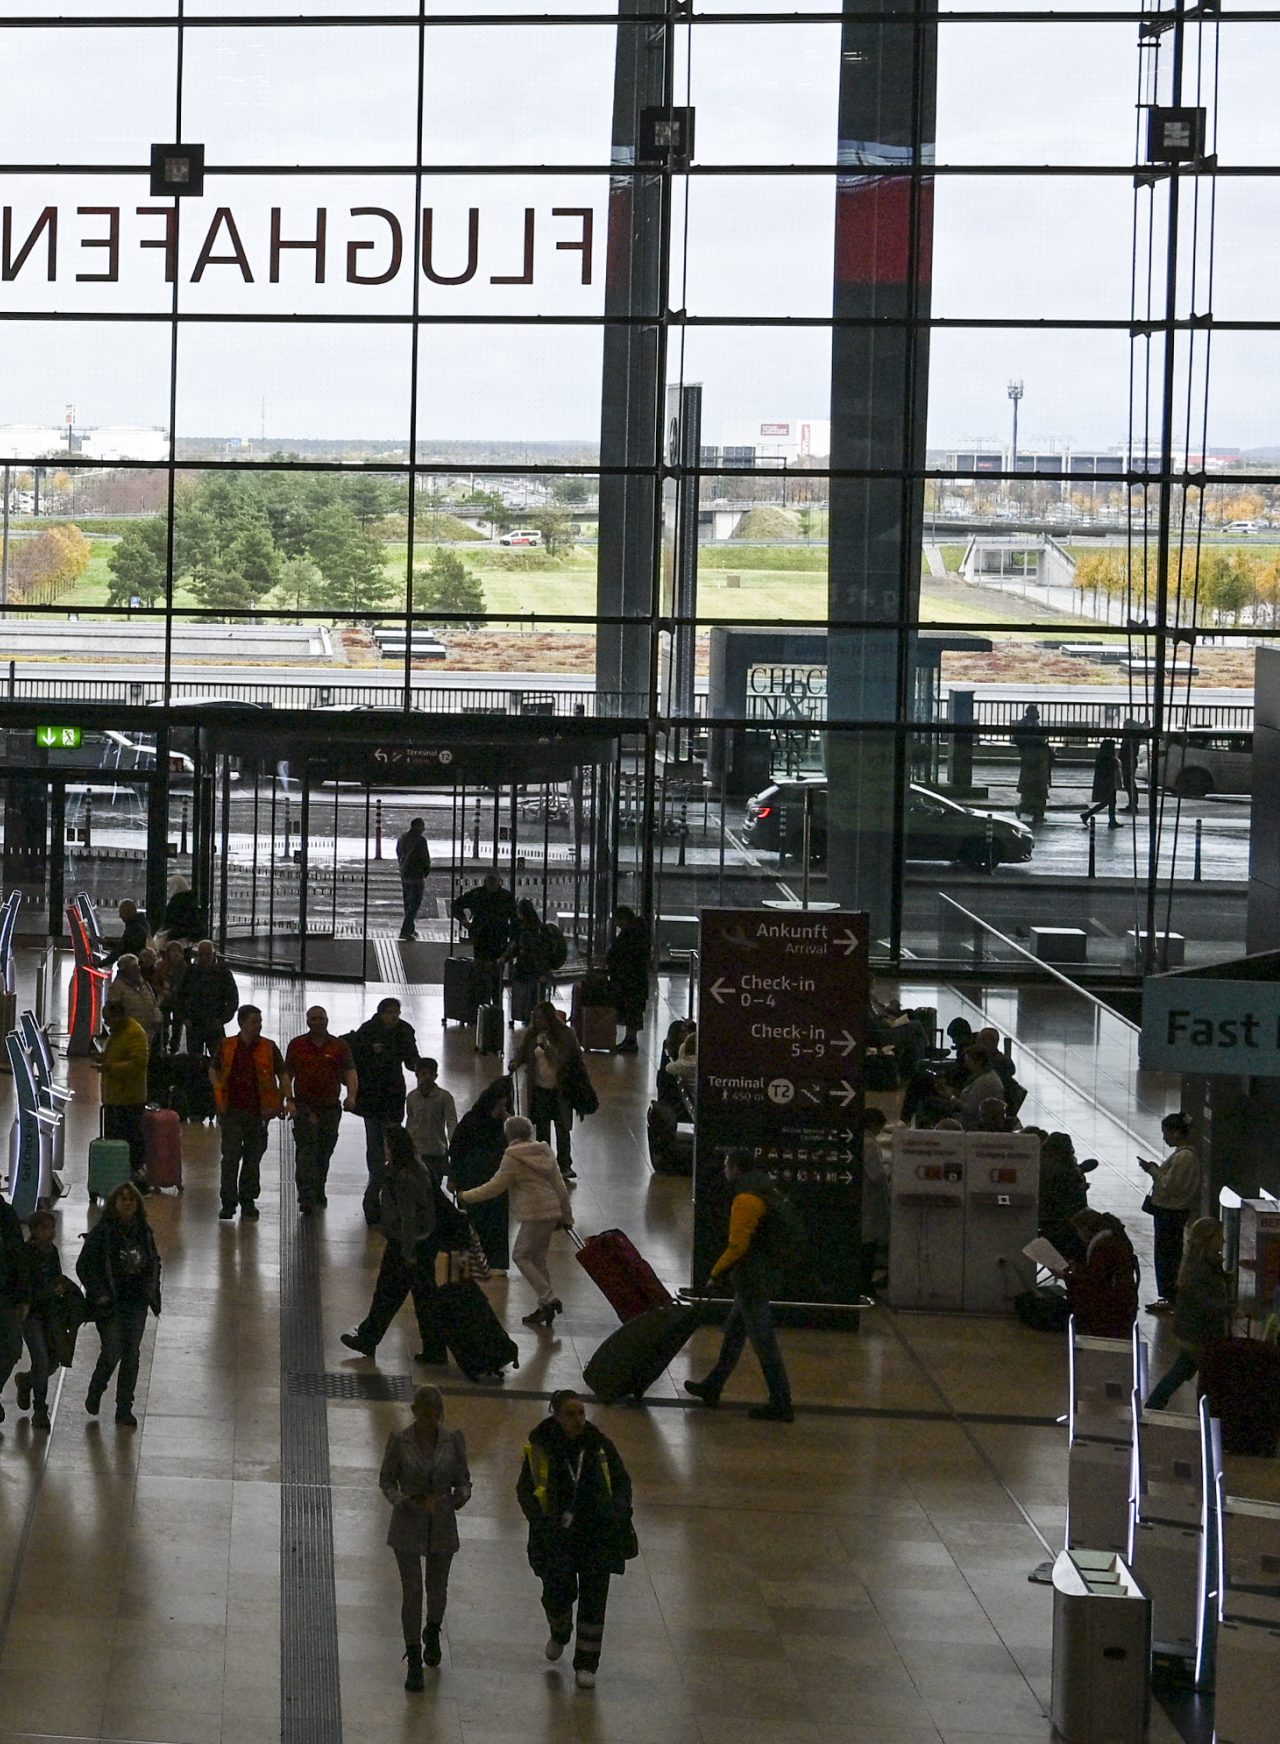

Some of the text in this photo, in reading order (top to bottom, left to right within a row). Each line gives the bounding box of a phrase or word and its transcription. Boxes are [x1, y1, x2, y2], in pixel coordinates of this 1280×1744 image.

[751, 667, 827, 695] CHEC
[756, 923, 829, 940] Ankunft
[785, 942, 828, 955] Arrival
[740, 974, 816, 992] Check-in
[751, 1023, 826, 1040] Check-in
[1167, 1009, 1260, 1049] Fast
[707, 1076, 791, 1098] Terminal T2
[754, 1147, 763, 1159] P
